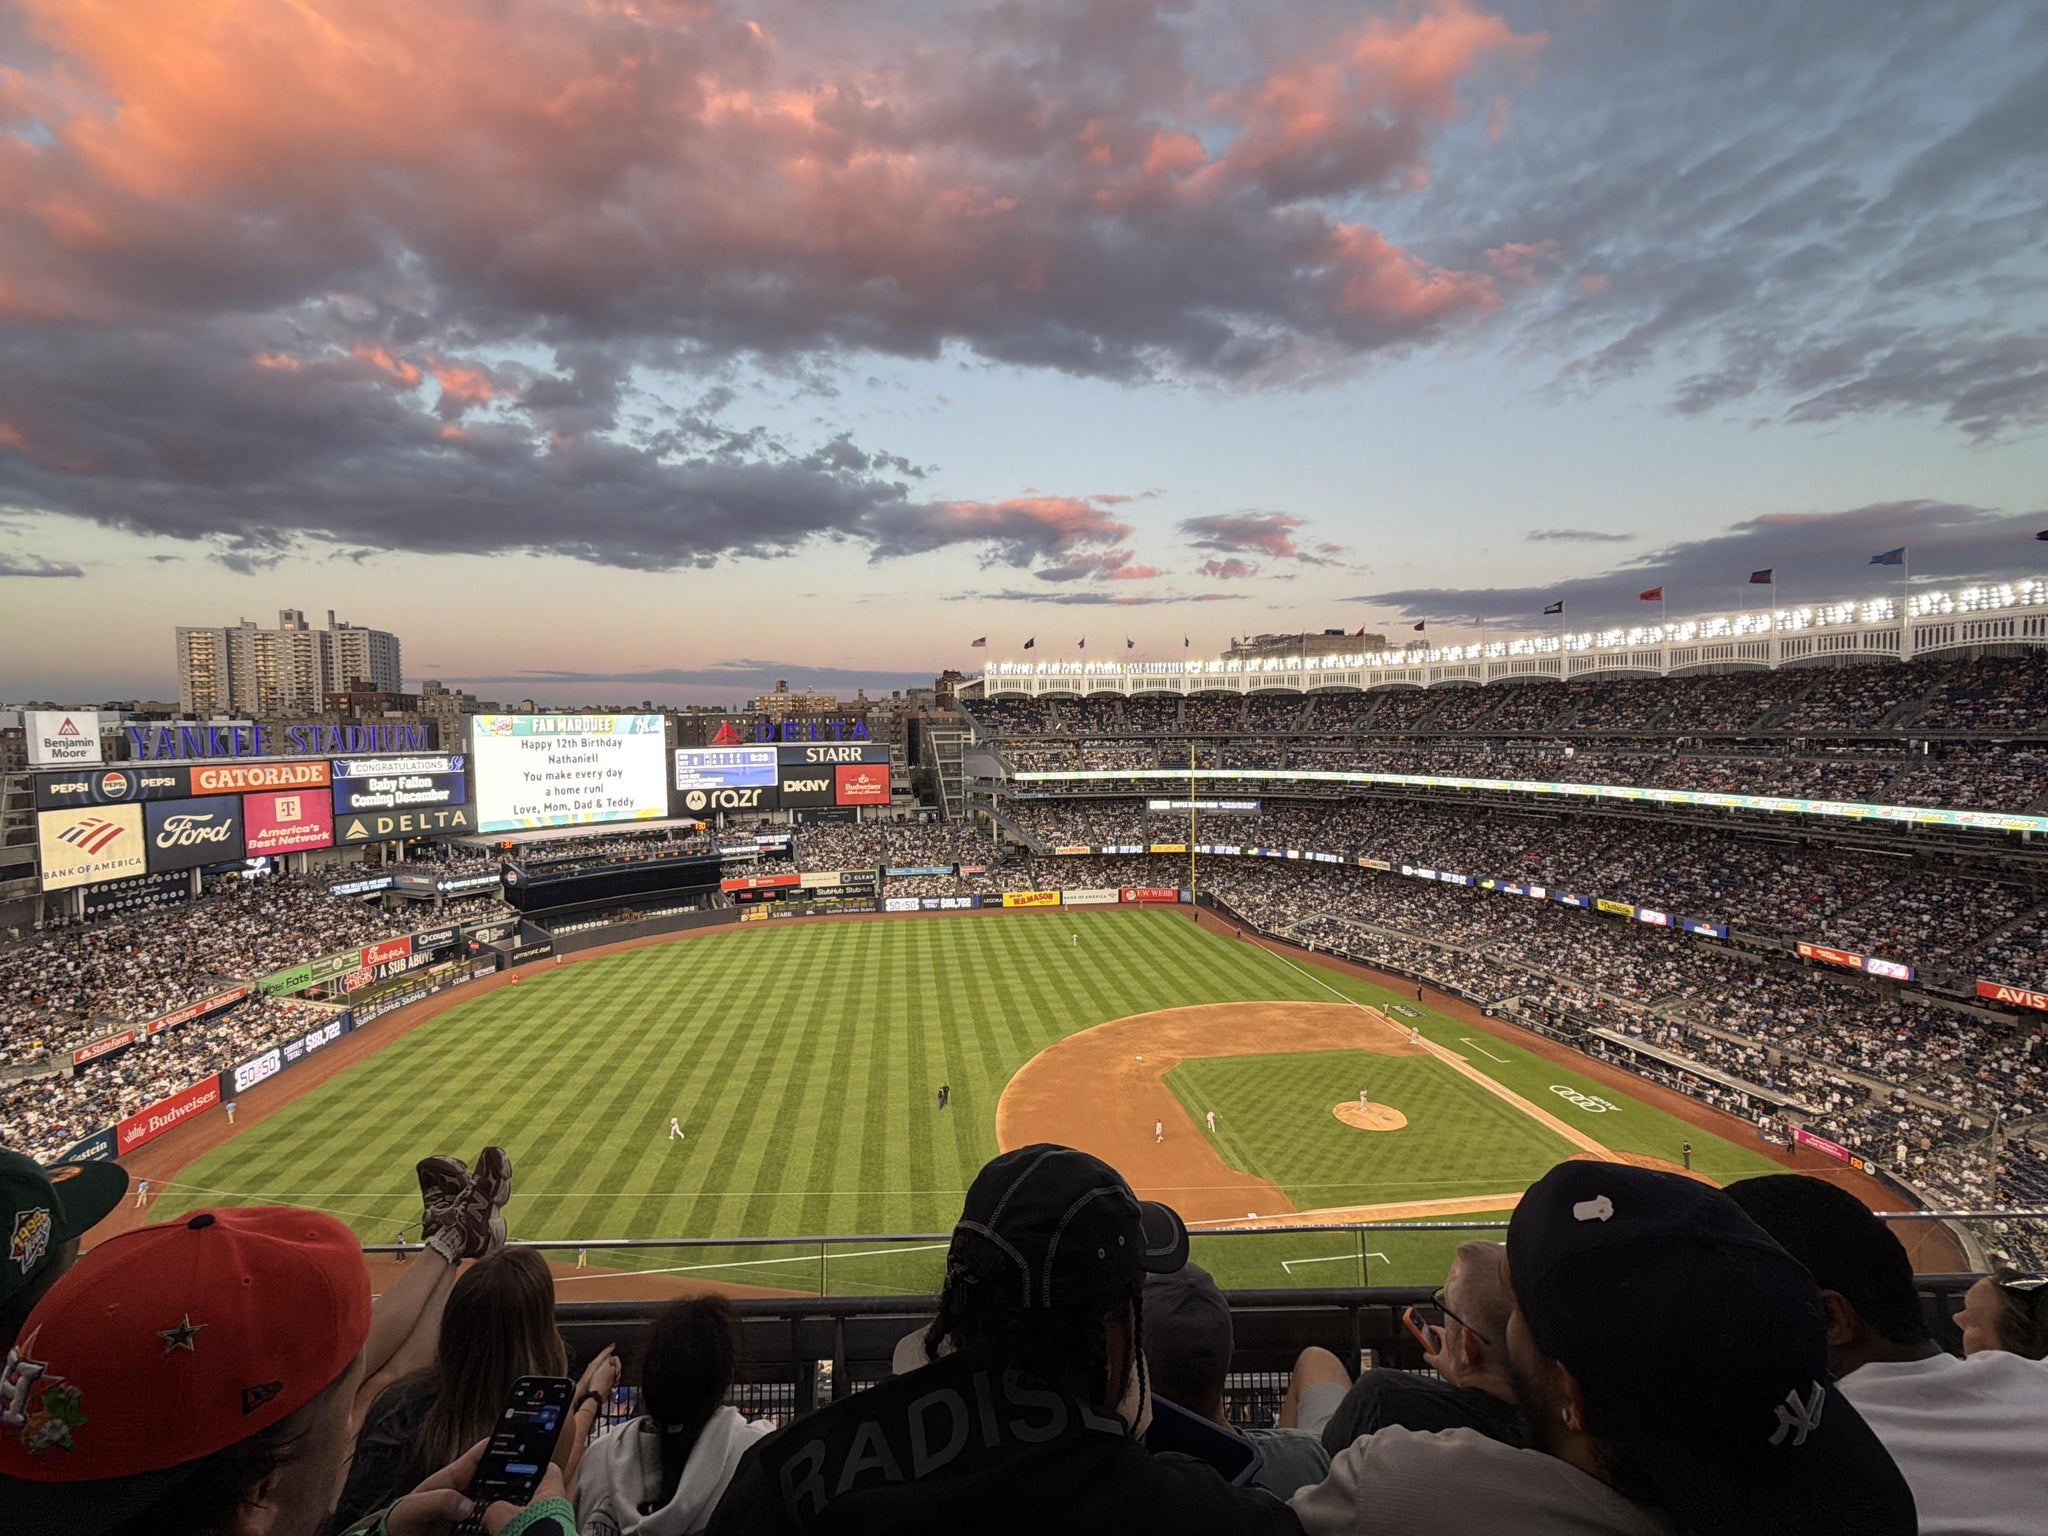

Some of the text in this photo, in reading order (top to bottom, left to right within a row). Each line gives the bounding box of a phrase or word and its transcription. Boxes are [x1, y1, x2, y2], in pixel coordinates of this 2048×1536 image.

[532, 718, 555, 733] FAN
[557, 717, 612, 733] MARQUEE
[755, 720, 870, 743] DELTA
[44, 736, 94, 750] Benjamin
[128, 724, 430, 760] YANKEE STADIUM
[521, 738, 623, 751] Happy 12th Birthday
[52, 749, 87, 758] Moore
[806, 747, 862, 762] STARR
[355, 760, 444, 772] CONGRATULATIONS
[141, 777, 176, 788] PEPSI
[200, 765, 324, 789] GATORADE
[523, 768, 623, 781] You make every day
[51, 782, 89, 794] PEPSI
[369, 778, 398, 792] Baby
[545, 788, 551, 796] a
[554, 785, 581, 796] home
[783, 779, 830, 793] DKNY
[845, 783, 882, 791] Budweiser
[351, 789, 450, 808] Coming December
[513, 797, 635, 815] Love, Mom, Dad & Teddy
[711, 788, 762, 809] razr
[377, 810, 468, 834] DELTA
[156, 813, 233, 848] Ford
[257, 823, 320, 839] America's
[248, 831, 330, 850] Best Network
[43, 857, 142, 880] BANK OF AMERICA
[816, 887, 844, 896] StubHub
[429, 930, 452, 941] coupa
[389, 960, 407, 974] SUB
[408, 951, 435, 968] ABOVE
[286, 972, 310, 988] Eats
[1996, 987, 2047, 1009] AVIS
